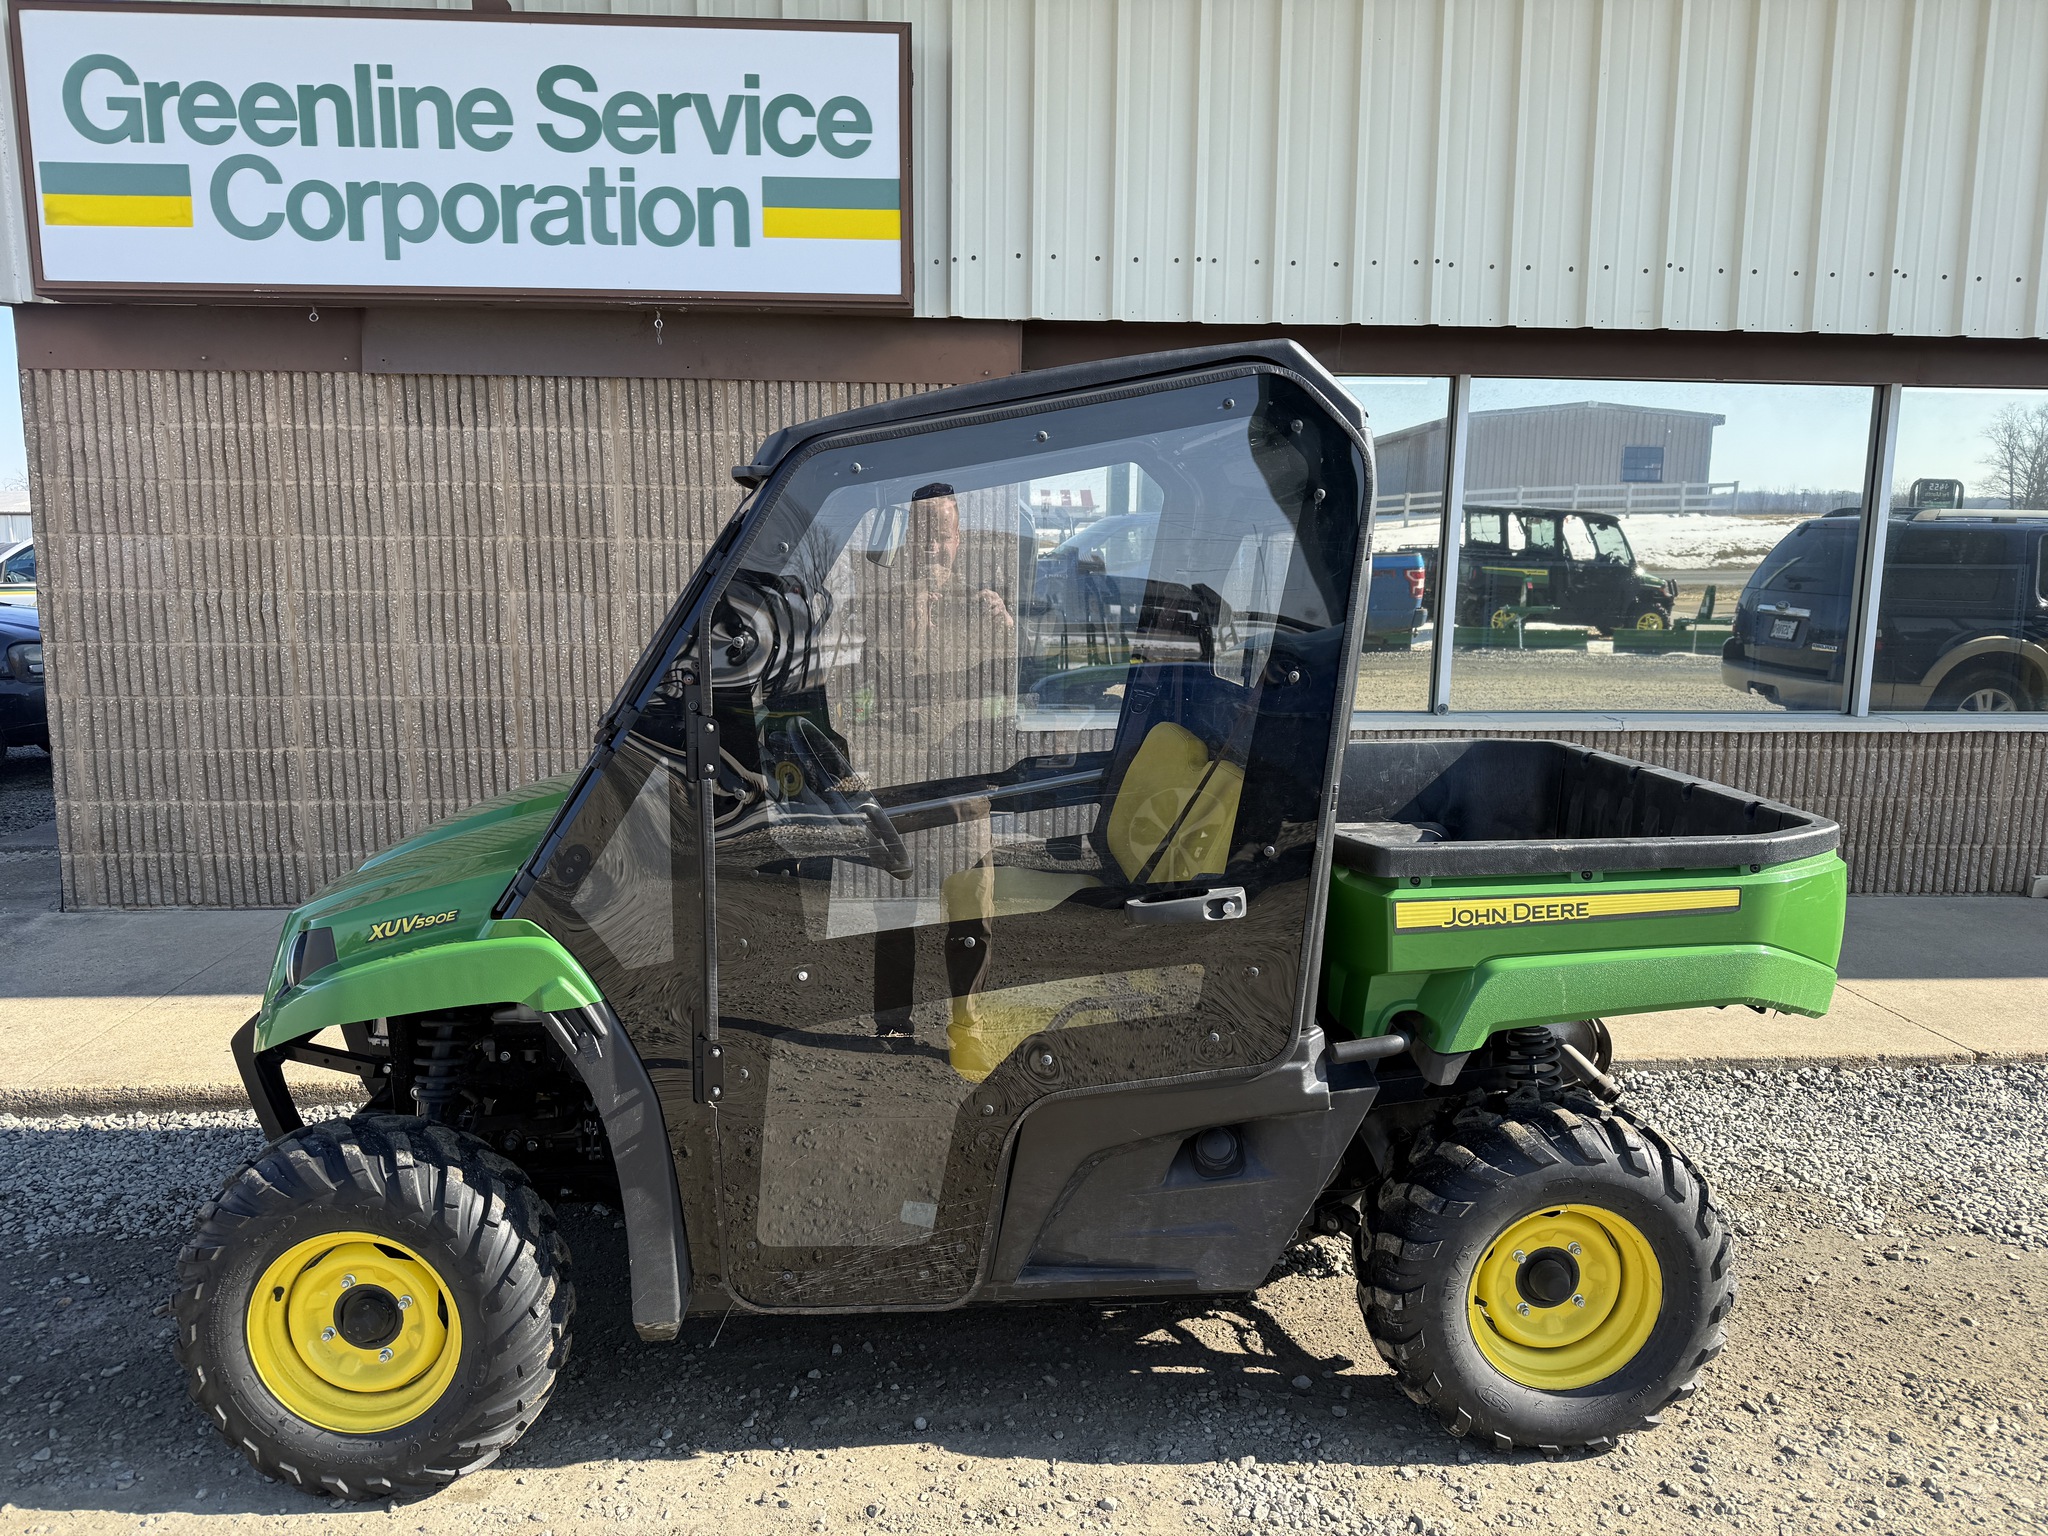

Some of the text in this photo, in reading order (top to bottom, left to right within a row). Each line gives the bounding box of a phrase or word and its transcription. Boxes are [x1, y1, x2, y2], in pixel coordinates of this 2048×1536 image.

[63, 54, 873, 159] Greenline Service
[210, 154, 751, 260] Corporation
[367, 909, 458, 942] XUV590E
[1444, 902, 1589, 925] JOHN DEERE
